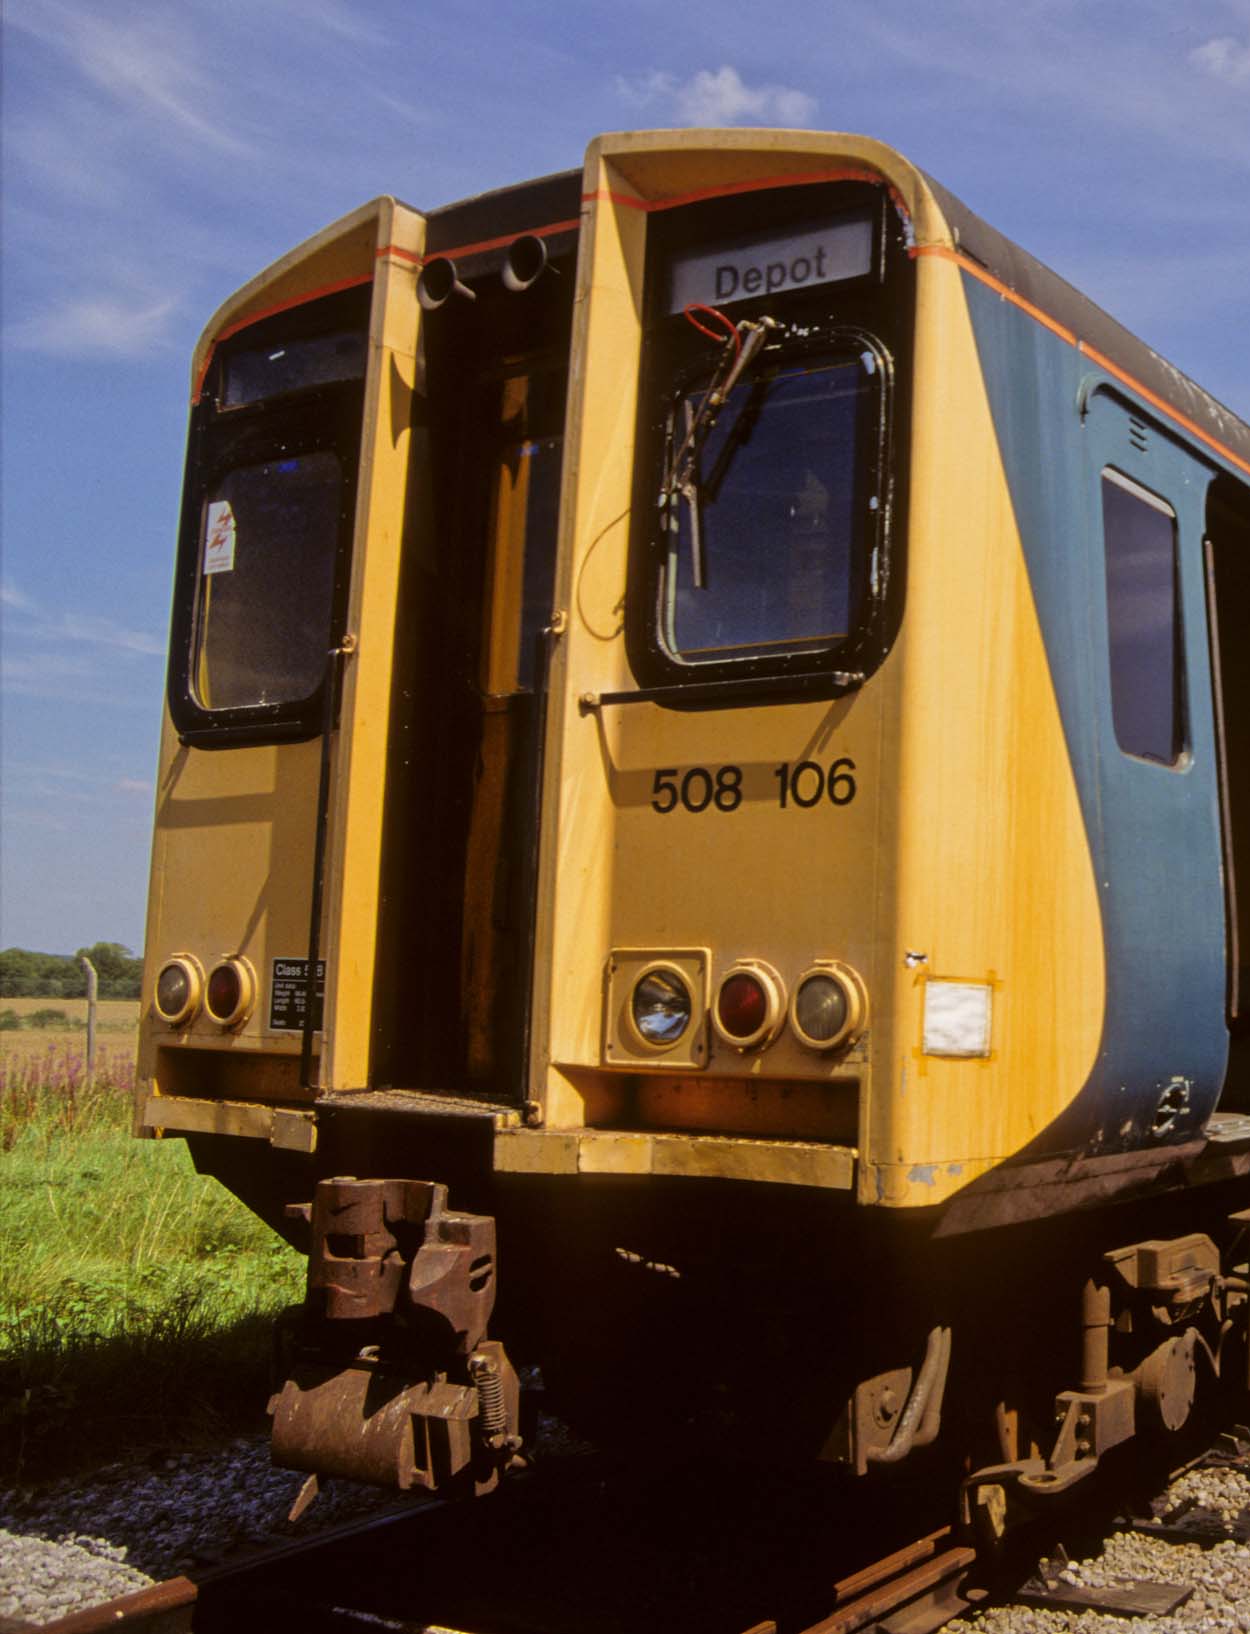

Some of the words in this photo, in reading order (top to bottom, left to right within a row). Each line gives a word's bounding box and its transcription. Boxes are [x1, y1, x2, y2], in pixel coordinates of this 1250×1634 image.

[714, 247, 827, 299] Depot
[652, 765, 743, 814] 508
[774, 758, 857, 806] 106
[275, 963, 302, 976] Class
